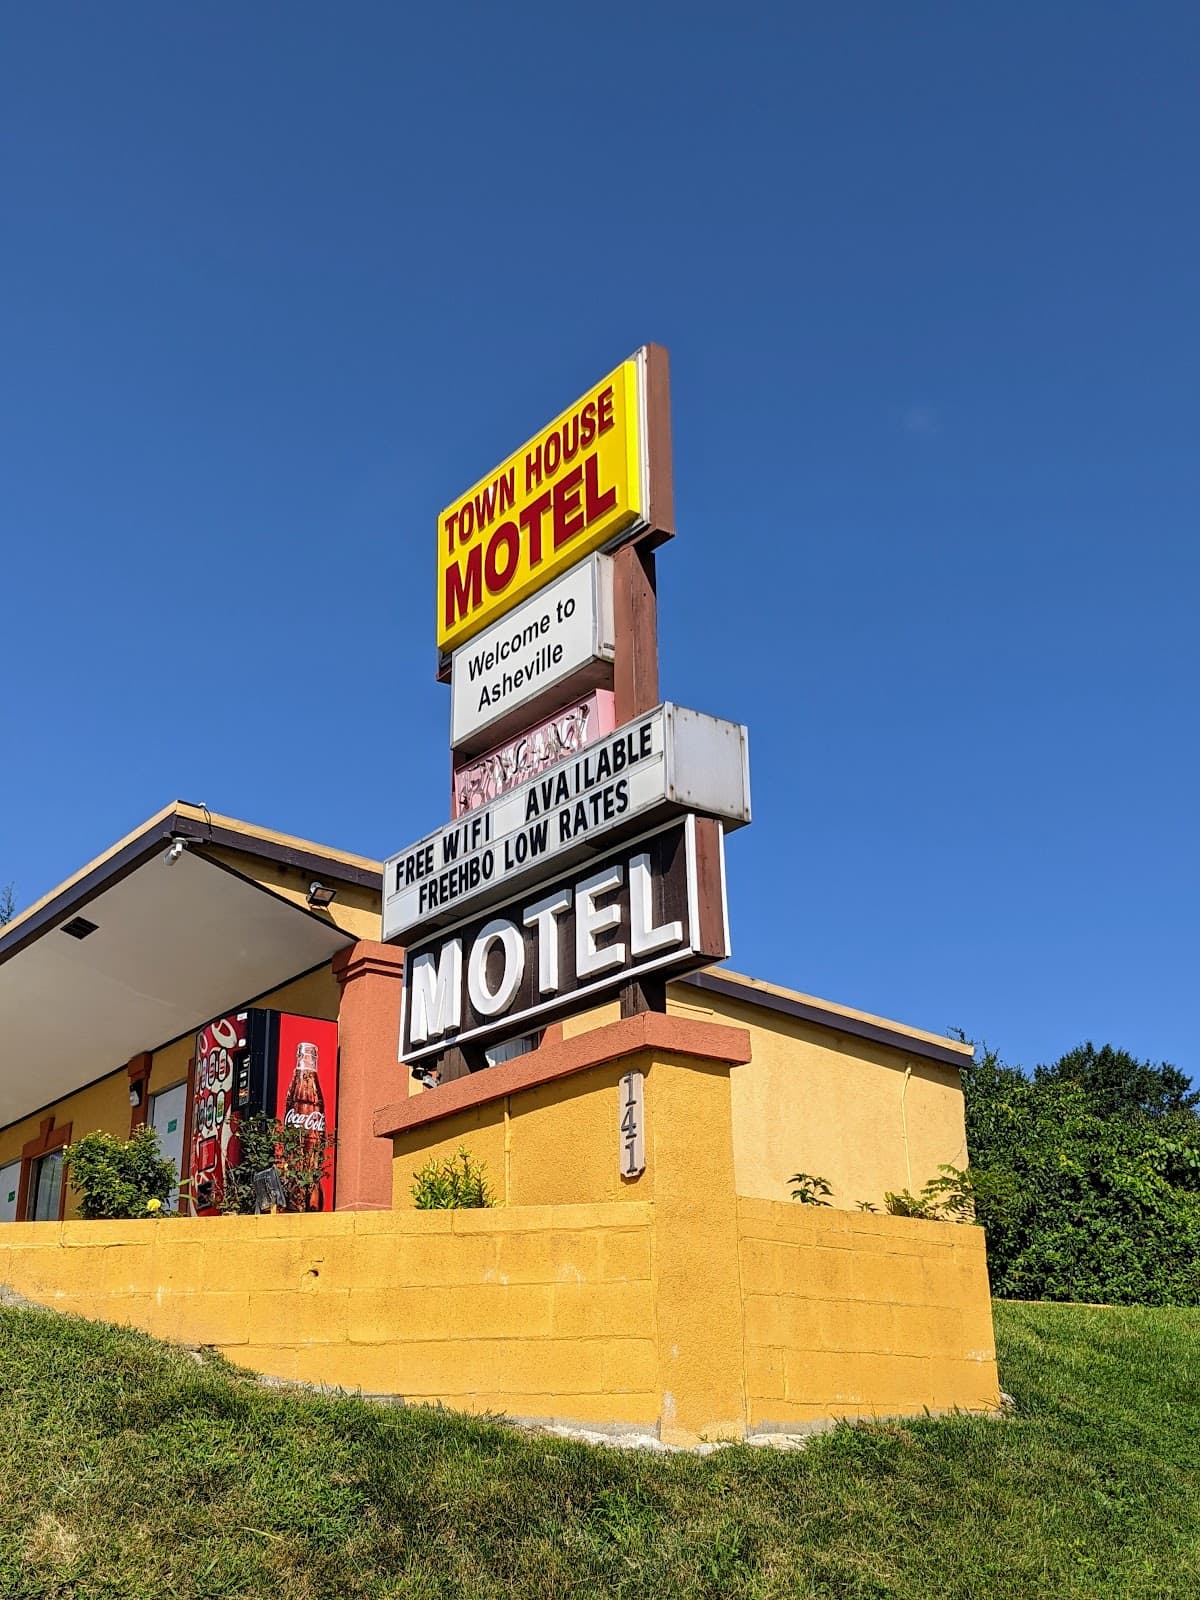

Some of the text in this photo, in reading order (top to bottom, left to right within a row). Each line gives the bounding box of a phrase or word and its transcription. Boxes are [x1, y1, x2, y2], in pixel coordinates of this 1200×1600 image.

[445, 385, 615, 554] TOWN HOUSE
[445, 452, 617, 632] MOTEL
[468, 598, 576, 682] Welcome to
[477, 643, 564, 712] Asheville
[395, 844, 434, 891] FREE
[443, 812, 490, 864] WIFI
[525, 722, 652, 821] AVAILABLE
[504, 820, 549, 871] LOW
[559, 779, 629, 843] RATES
[410, 853, 683, 1045] MOTEL
